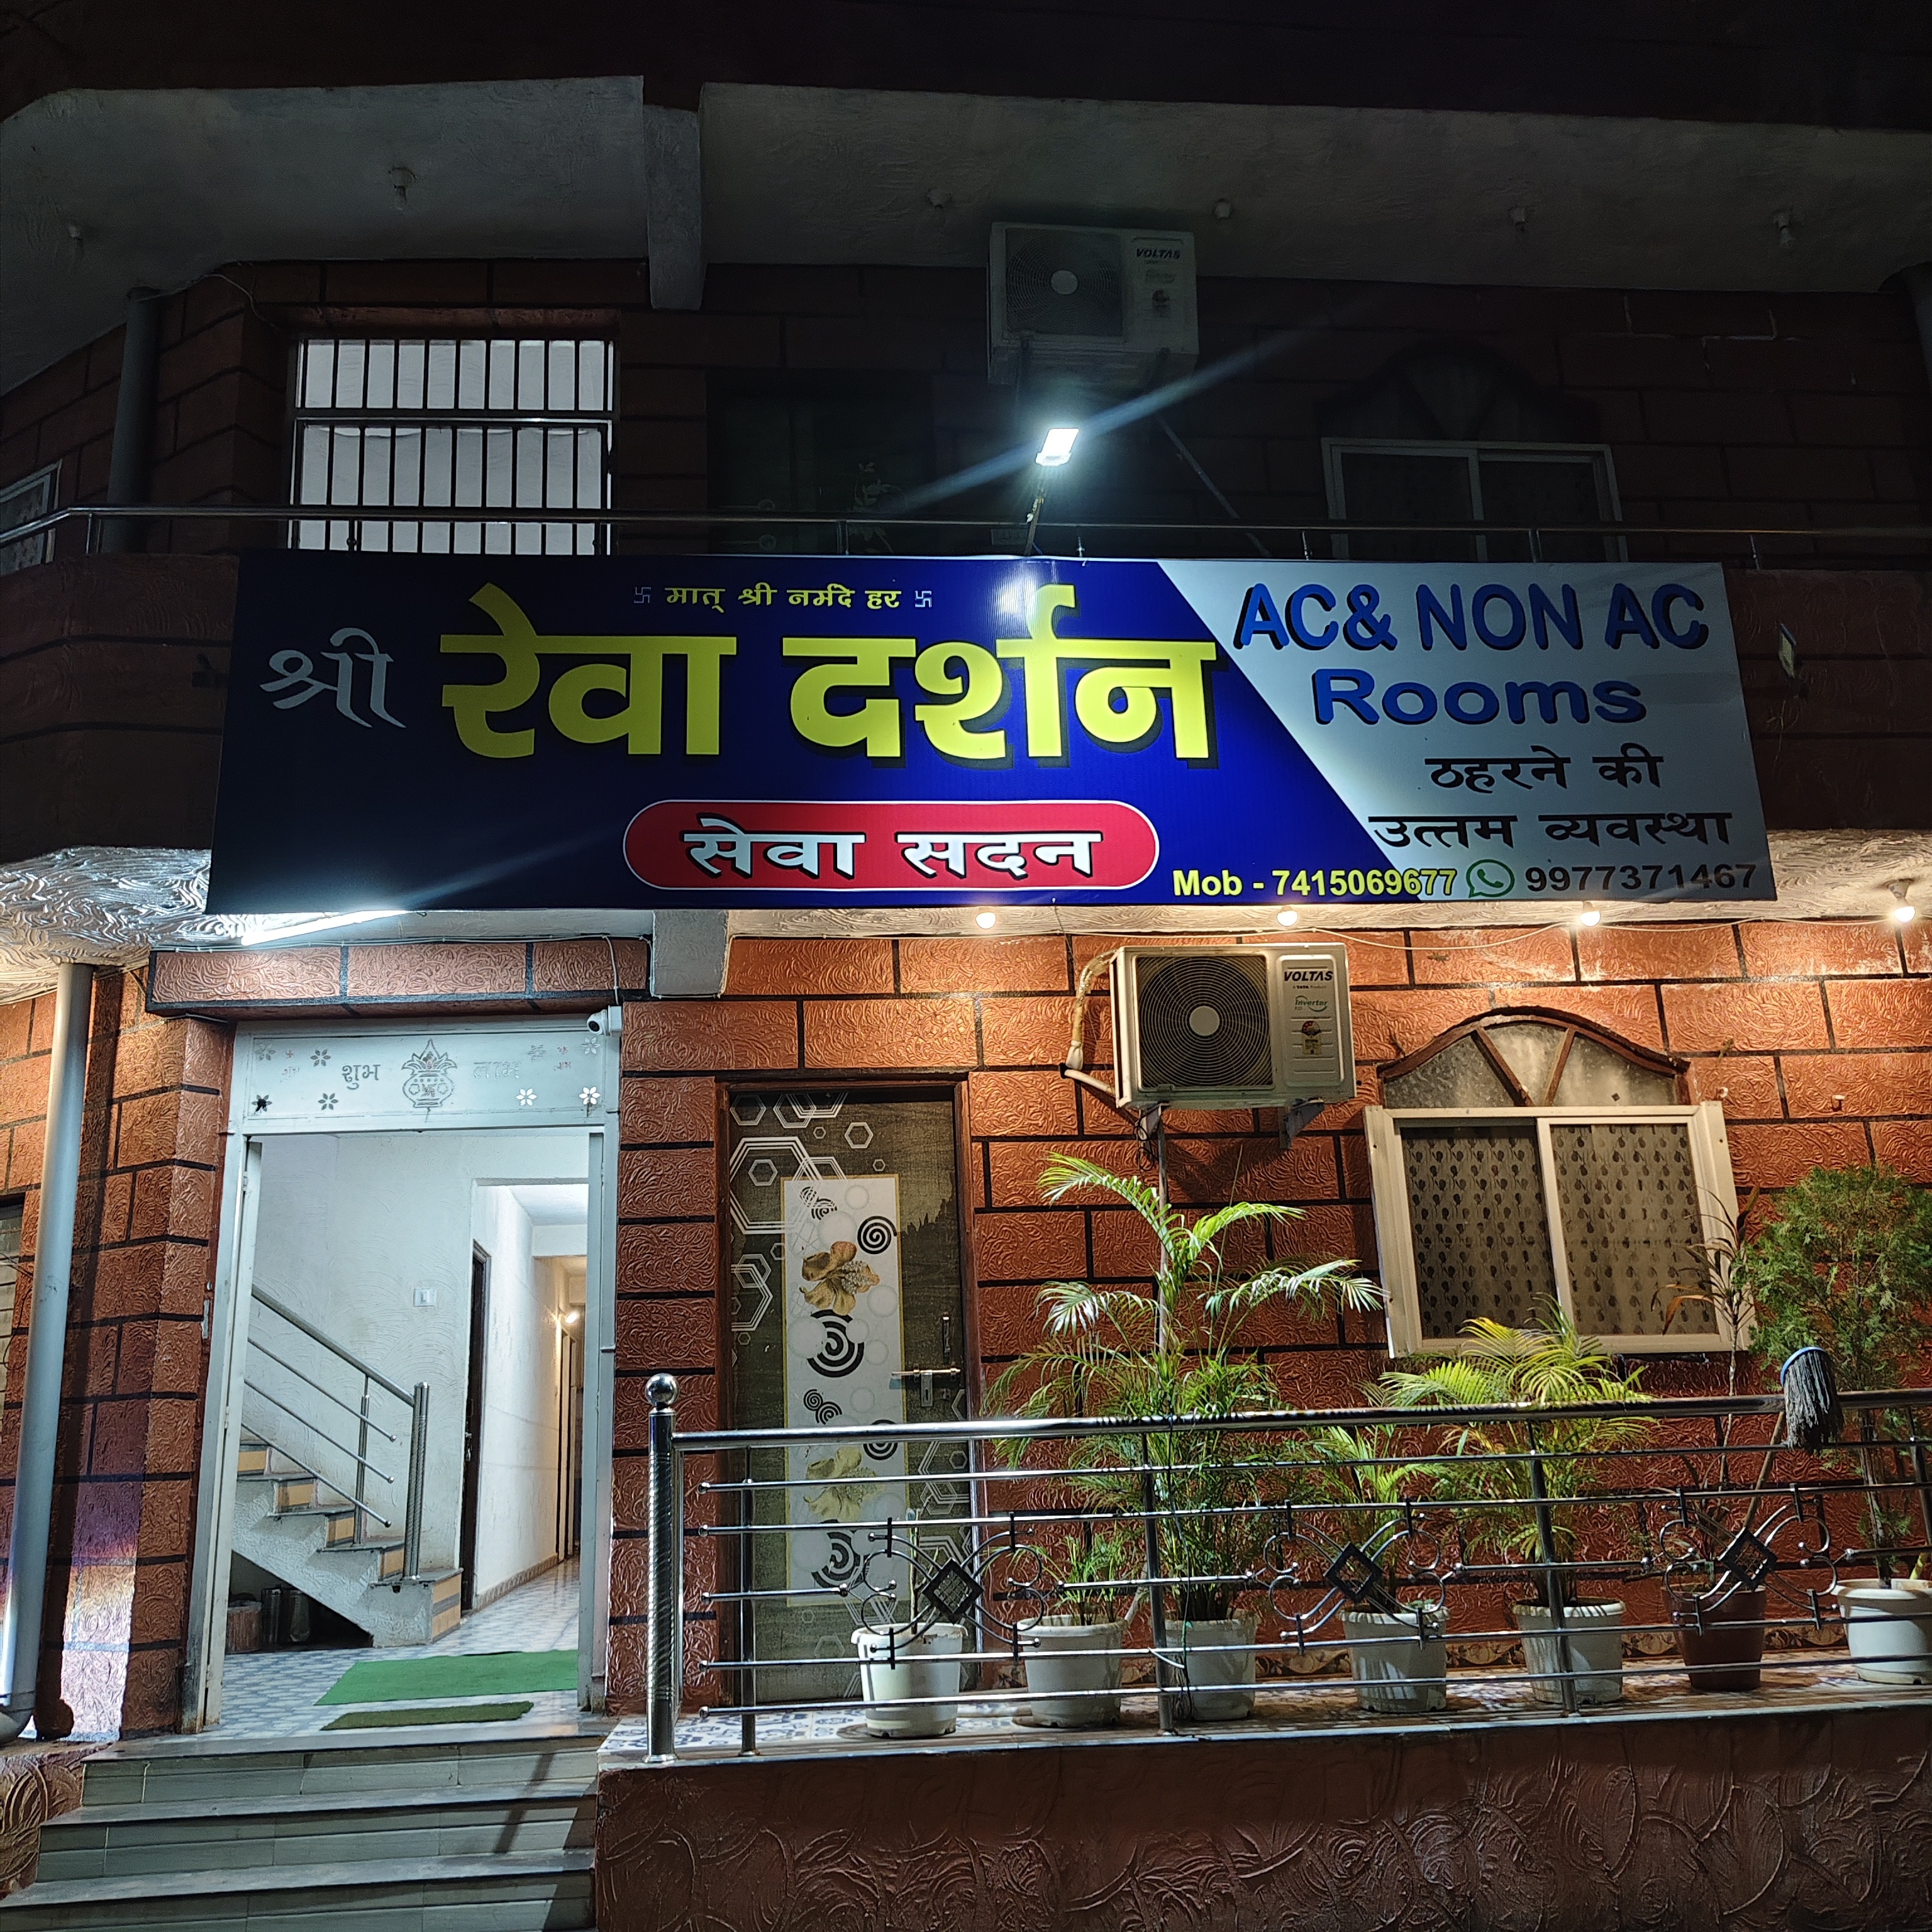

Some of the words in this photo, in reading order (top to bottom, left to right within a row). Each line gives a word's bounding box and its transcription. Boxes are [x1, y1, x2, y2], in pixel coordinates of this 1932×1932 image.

[1136, 248, 1181, 260] VOLTAS
[738, 582, 777, 606] श्री
[786, 583, 856, 608] नर्मदे
[864, 590, 902, 609] हर
[1233, 582, 1397, 650] AC&
[1416, 583, 1583, 650] NON
[1604, 583, 1709, 650] AC
[260, 627, 406, 728] श्री
[440, 582, 738, 758] रेवा
[782, 584, 1217, 760] दर्शन
[1312, 668, 1647, 726] Rooms
[1424, 745, 1572, 794] ठहरने
[1592, 743, 1663, 789] की
[683, 817, 865, 877] सेवा
[896, 831, 1103, 877] सदन
[1368, 815, 1518, 848] उत्तम
[1538, 812, 1732, 845] व्यवस्था
[1173, 870, 1242, 896] Mob
[1272, 869, 1458, 896] 7415069677
[1526, 863, 1757, 892] 9977371467
[1284, 971, 1333, 981] VOLTAS
[341, 1063, 381, 1090] शुभ
